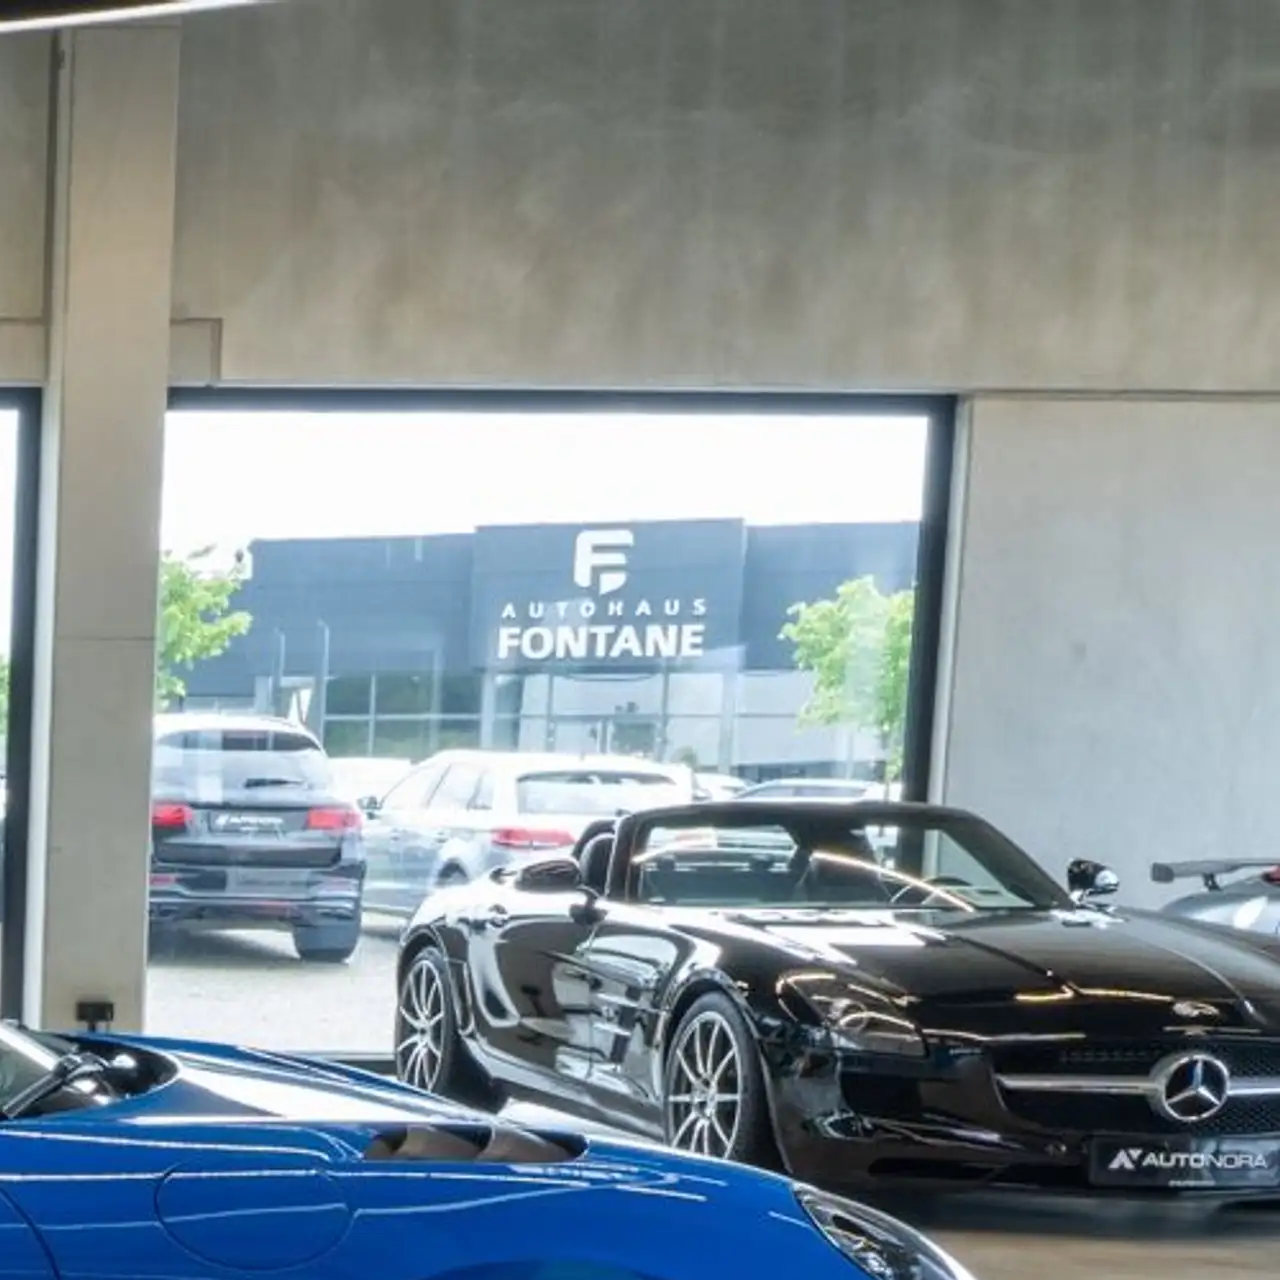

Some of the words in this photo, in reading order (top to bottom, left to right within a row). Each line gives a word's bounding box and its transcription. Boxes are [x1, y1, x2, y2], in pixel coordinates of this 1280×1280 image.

[500, 598, 707, 619] AUTOHAUS
[496, 624, 707, 660] FONTANE
[1141, 1152, 1269, 1169] AUTONORA
